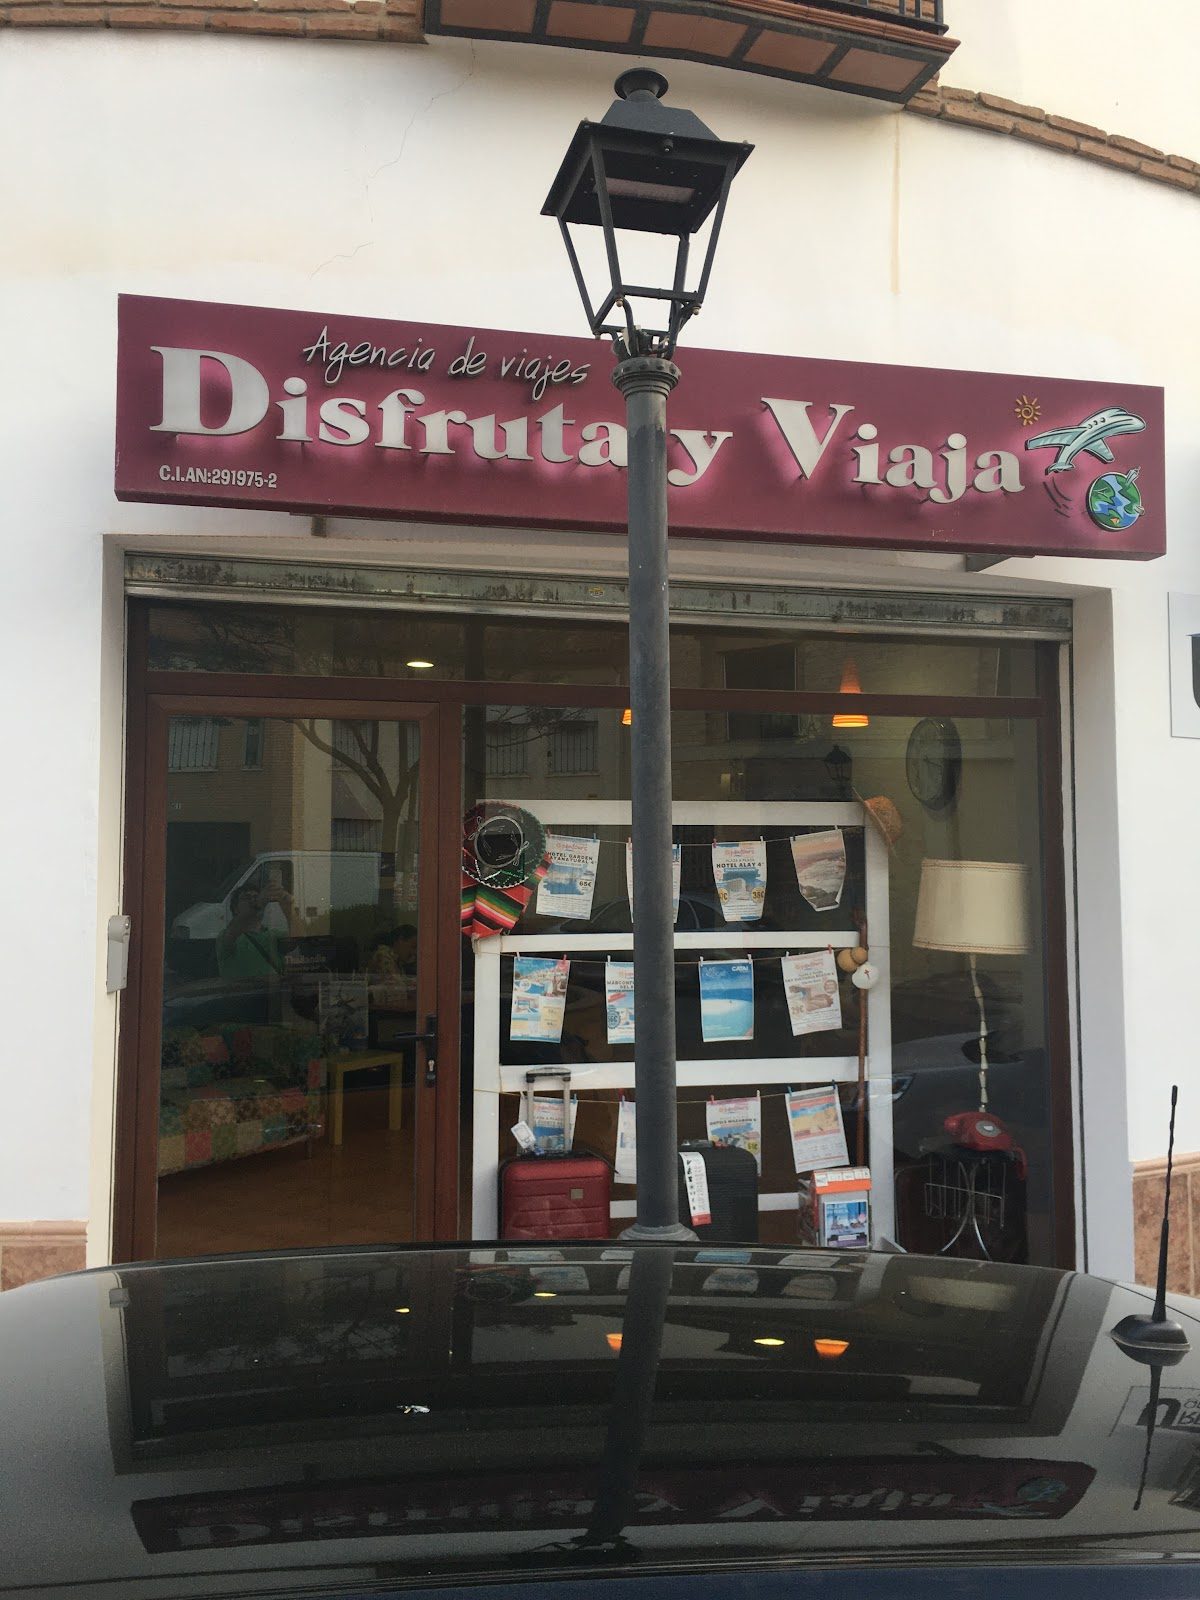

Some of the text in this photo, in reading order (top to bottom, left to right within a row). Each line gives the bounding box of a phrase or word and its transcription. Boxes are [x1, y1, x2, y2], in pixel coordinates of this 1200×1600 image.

[303, 325, 591, 401] Agencia de viajes
[149, 345, 1026, 504] Disfruta y Viaja
[159, 464, 278, 489] C.I.AN:291975-2
